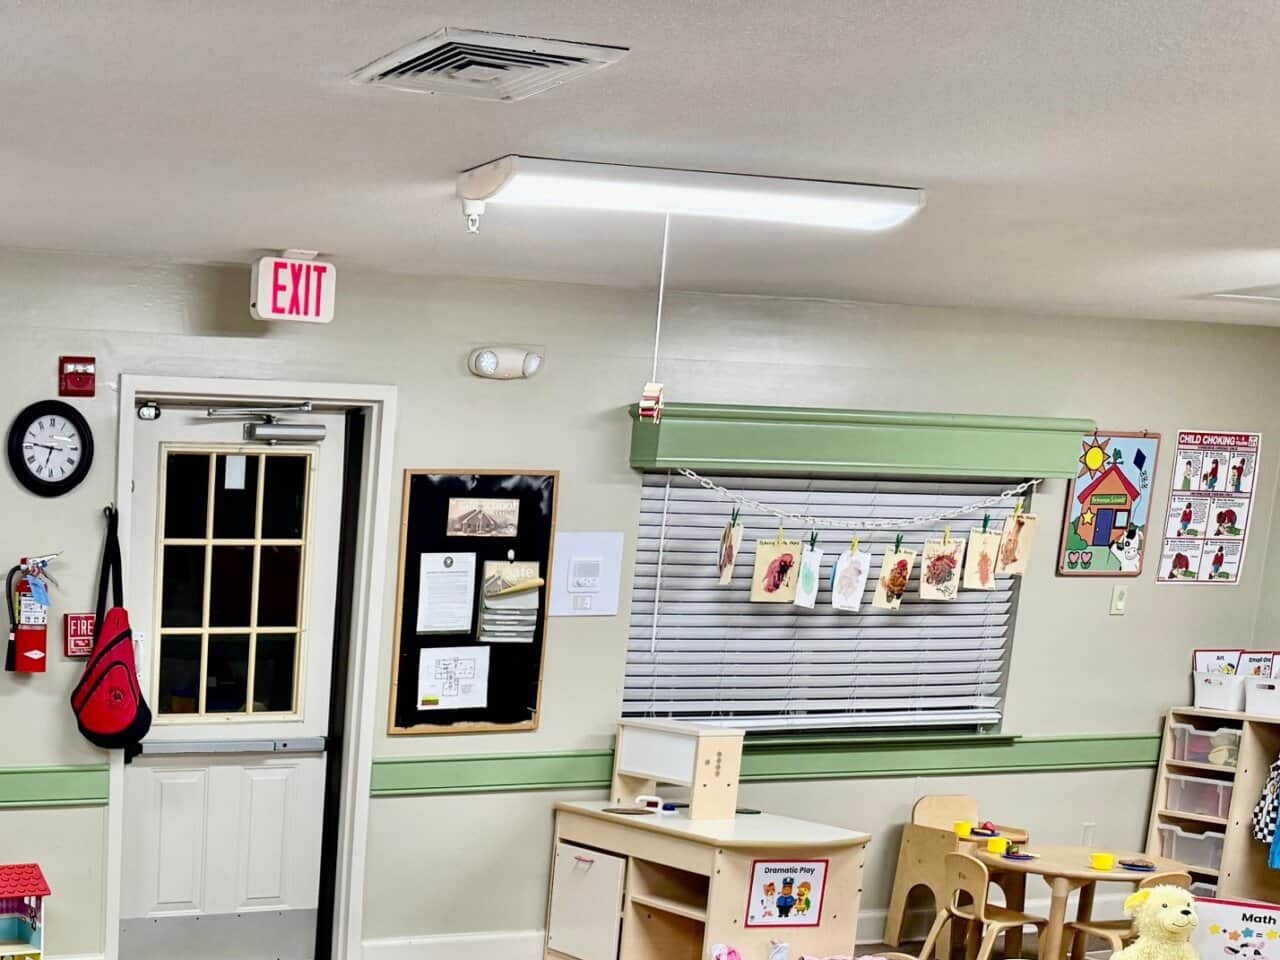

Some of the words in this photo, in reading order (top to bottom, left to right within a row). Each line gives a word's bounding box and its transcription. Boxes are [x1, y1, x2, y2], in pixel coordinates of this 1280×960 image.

[271, 261, 327, 317] EXIT
[1180, 434, 1201, 444] CHILD
[1202, 435, 1235, 446] CHOKING
[71, 620, 95, 636] FIRE
[764, 865, 799, 874] Dramatic
[800, 866, 816, 876] Play
[1242, 912, 1277, 925] Math
